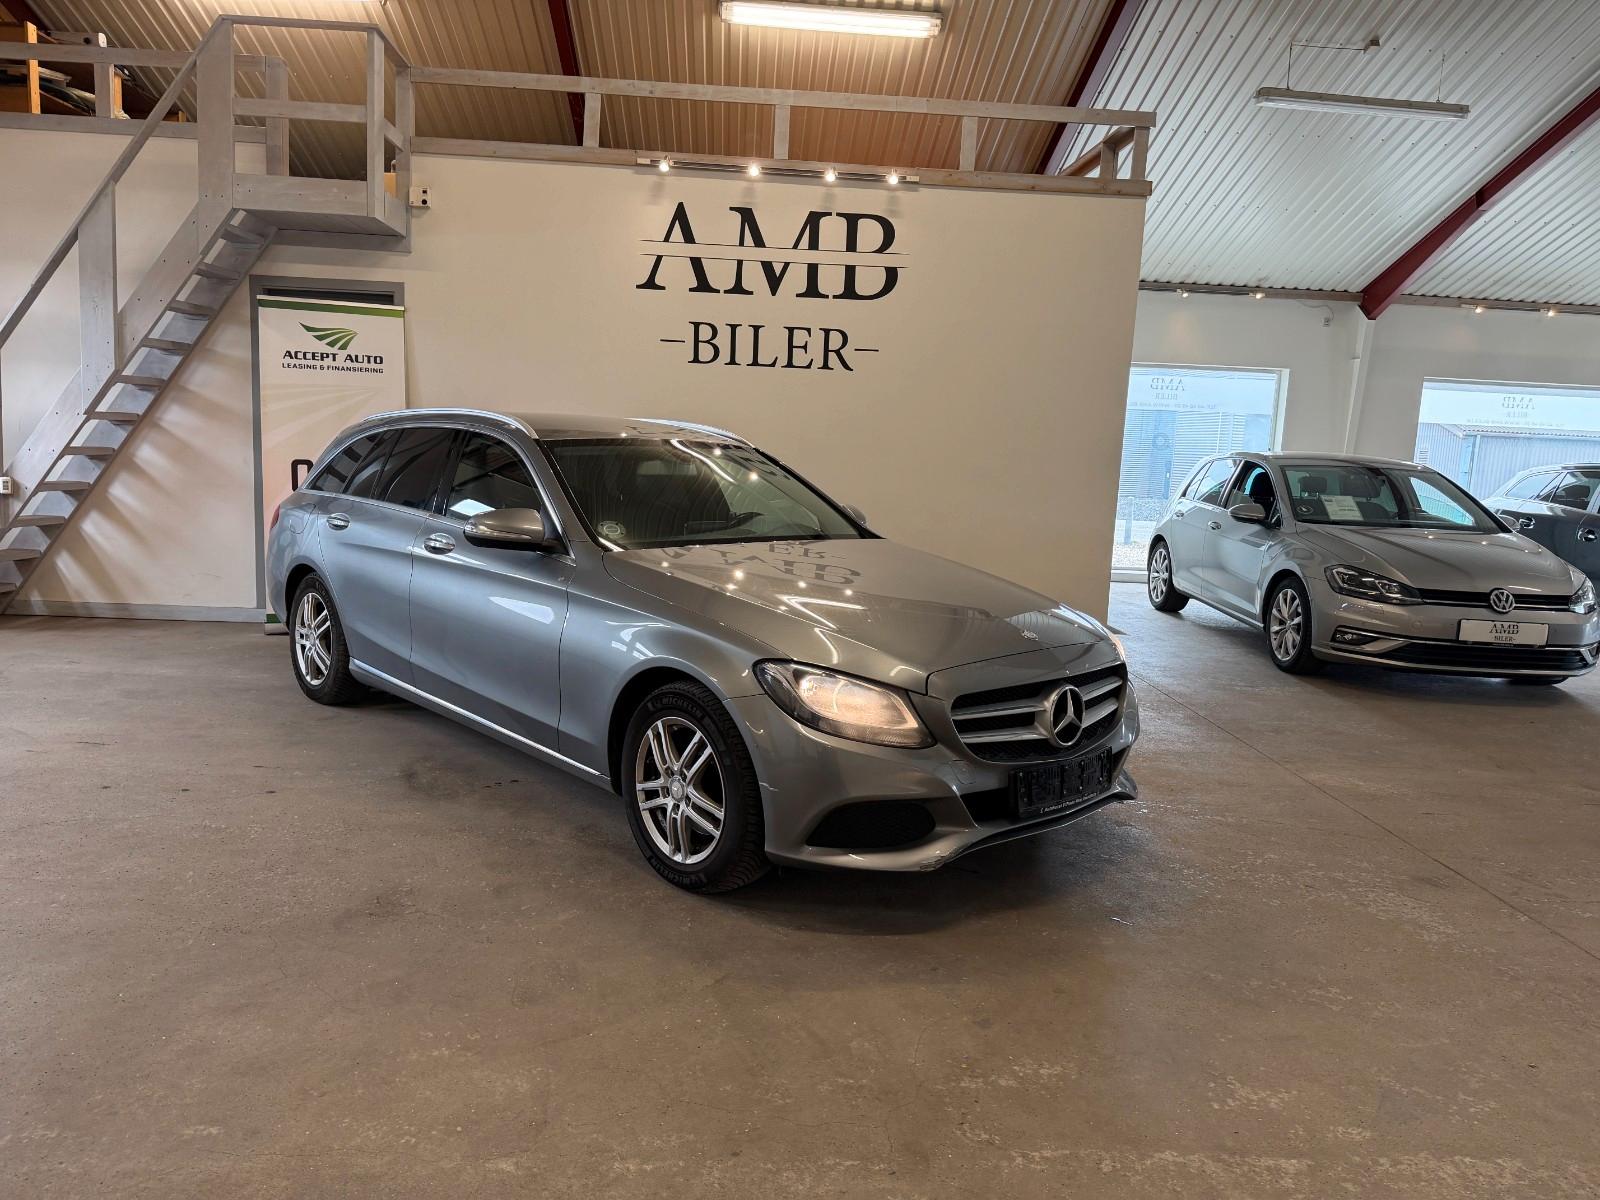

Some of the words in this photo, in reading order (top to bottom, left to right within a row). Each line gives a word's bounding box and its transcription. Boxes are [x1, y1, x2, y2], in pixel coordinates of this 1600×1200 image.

[636, 202, 899, 300] AMB
[283, 350, 339, 362] ACCEPT
[344, 354, 384, 365] AUTO
[327, 365, 384, 374] FINANSIERING
[1488, 623, 1519, 635] AMB
